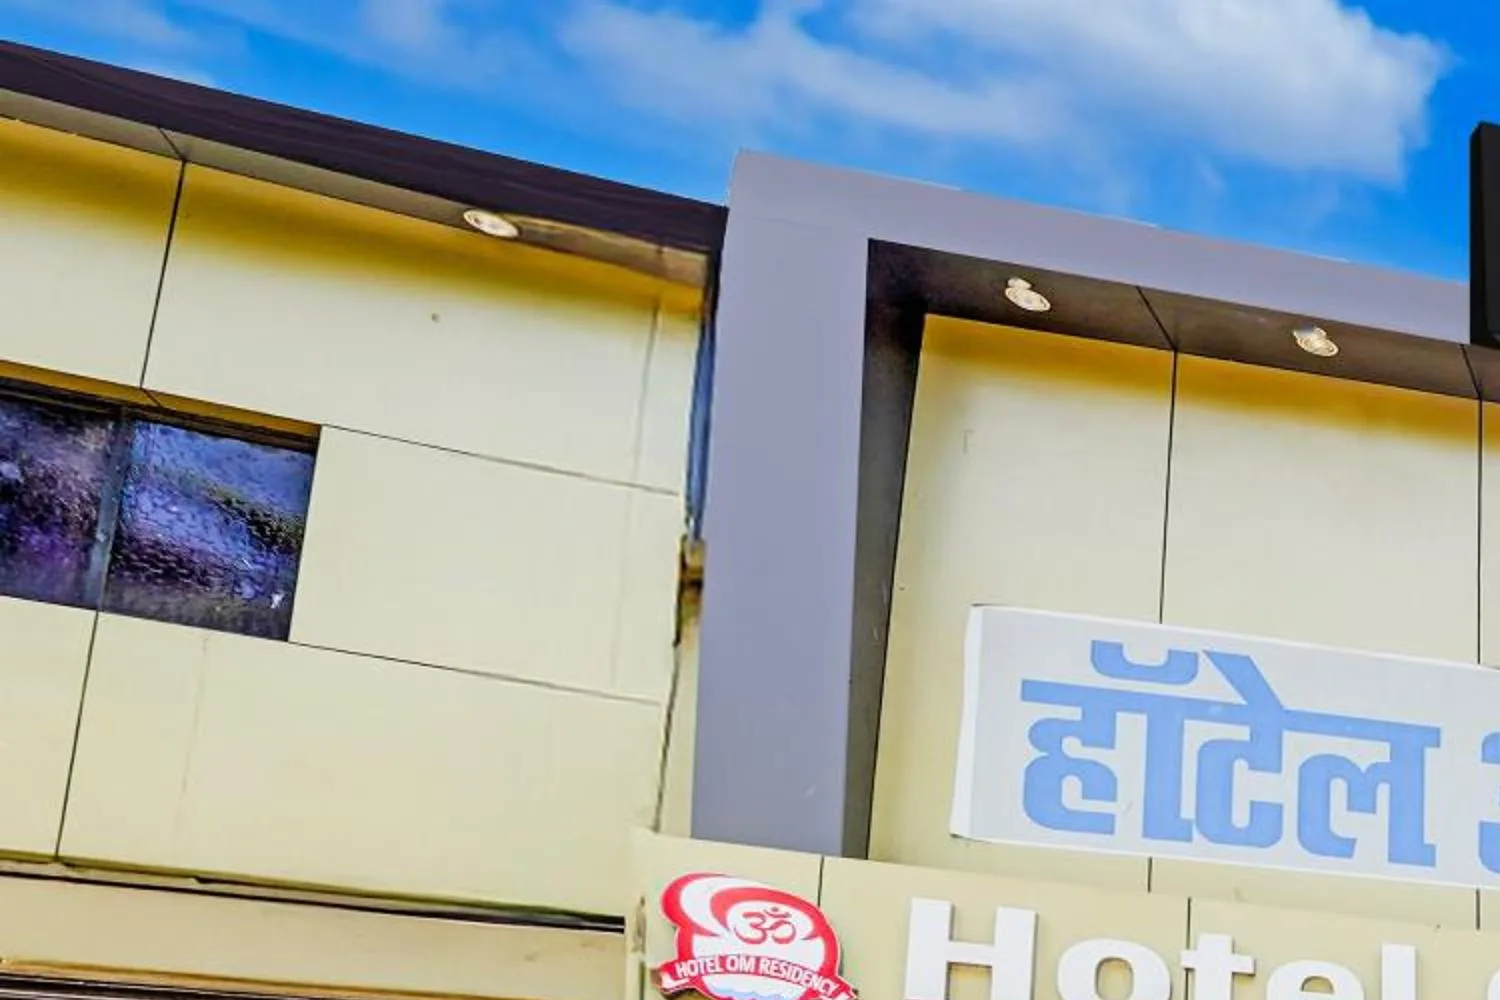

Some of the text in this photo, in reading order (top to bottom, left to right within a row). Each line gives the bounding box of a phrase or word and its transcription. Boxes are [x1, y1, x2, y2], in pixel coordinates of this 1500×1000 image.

[1020, 639, 1441, 868] हॉटेल
[675, 955, 840, 996] HOTEL OM RESIDENCY
